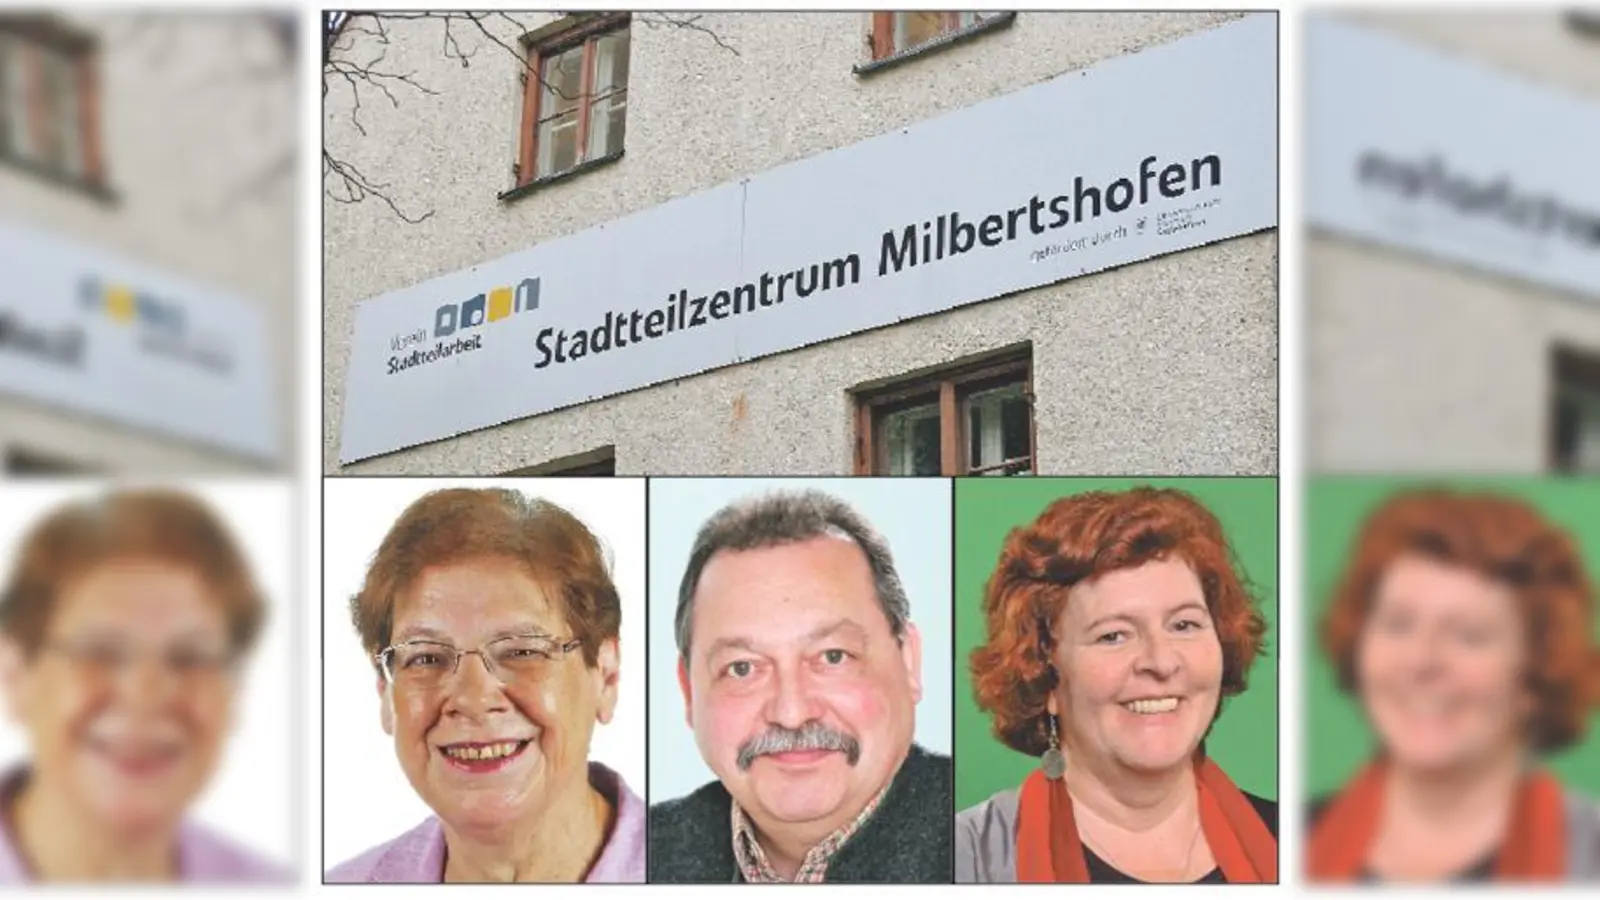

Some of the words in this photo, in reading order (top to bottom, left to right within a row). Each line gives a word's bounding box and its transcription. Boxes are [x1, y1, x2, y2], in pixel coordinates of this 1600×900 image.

[534, 253, 859, 369] Stadtteilzentrum
[878, 154, 1222, 276] Milbertshofen
[386, 335, 482, 375] Stadtteilarbeit
